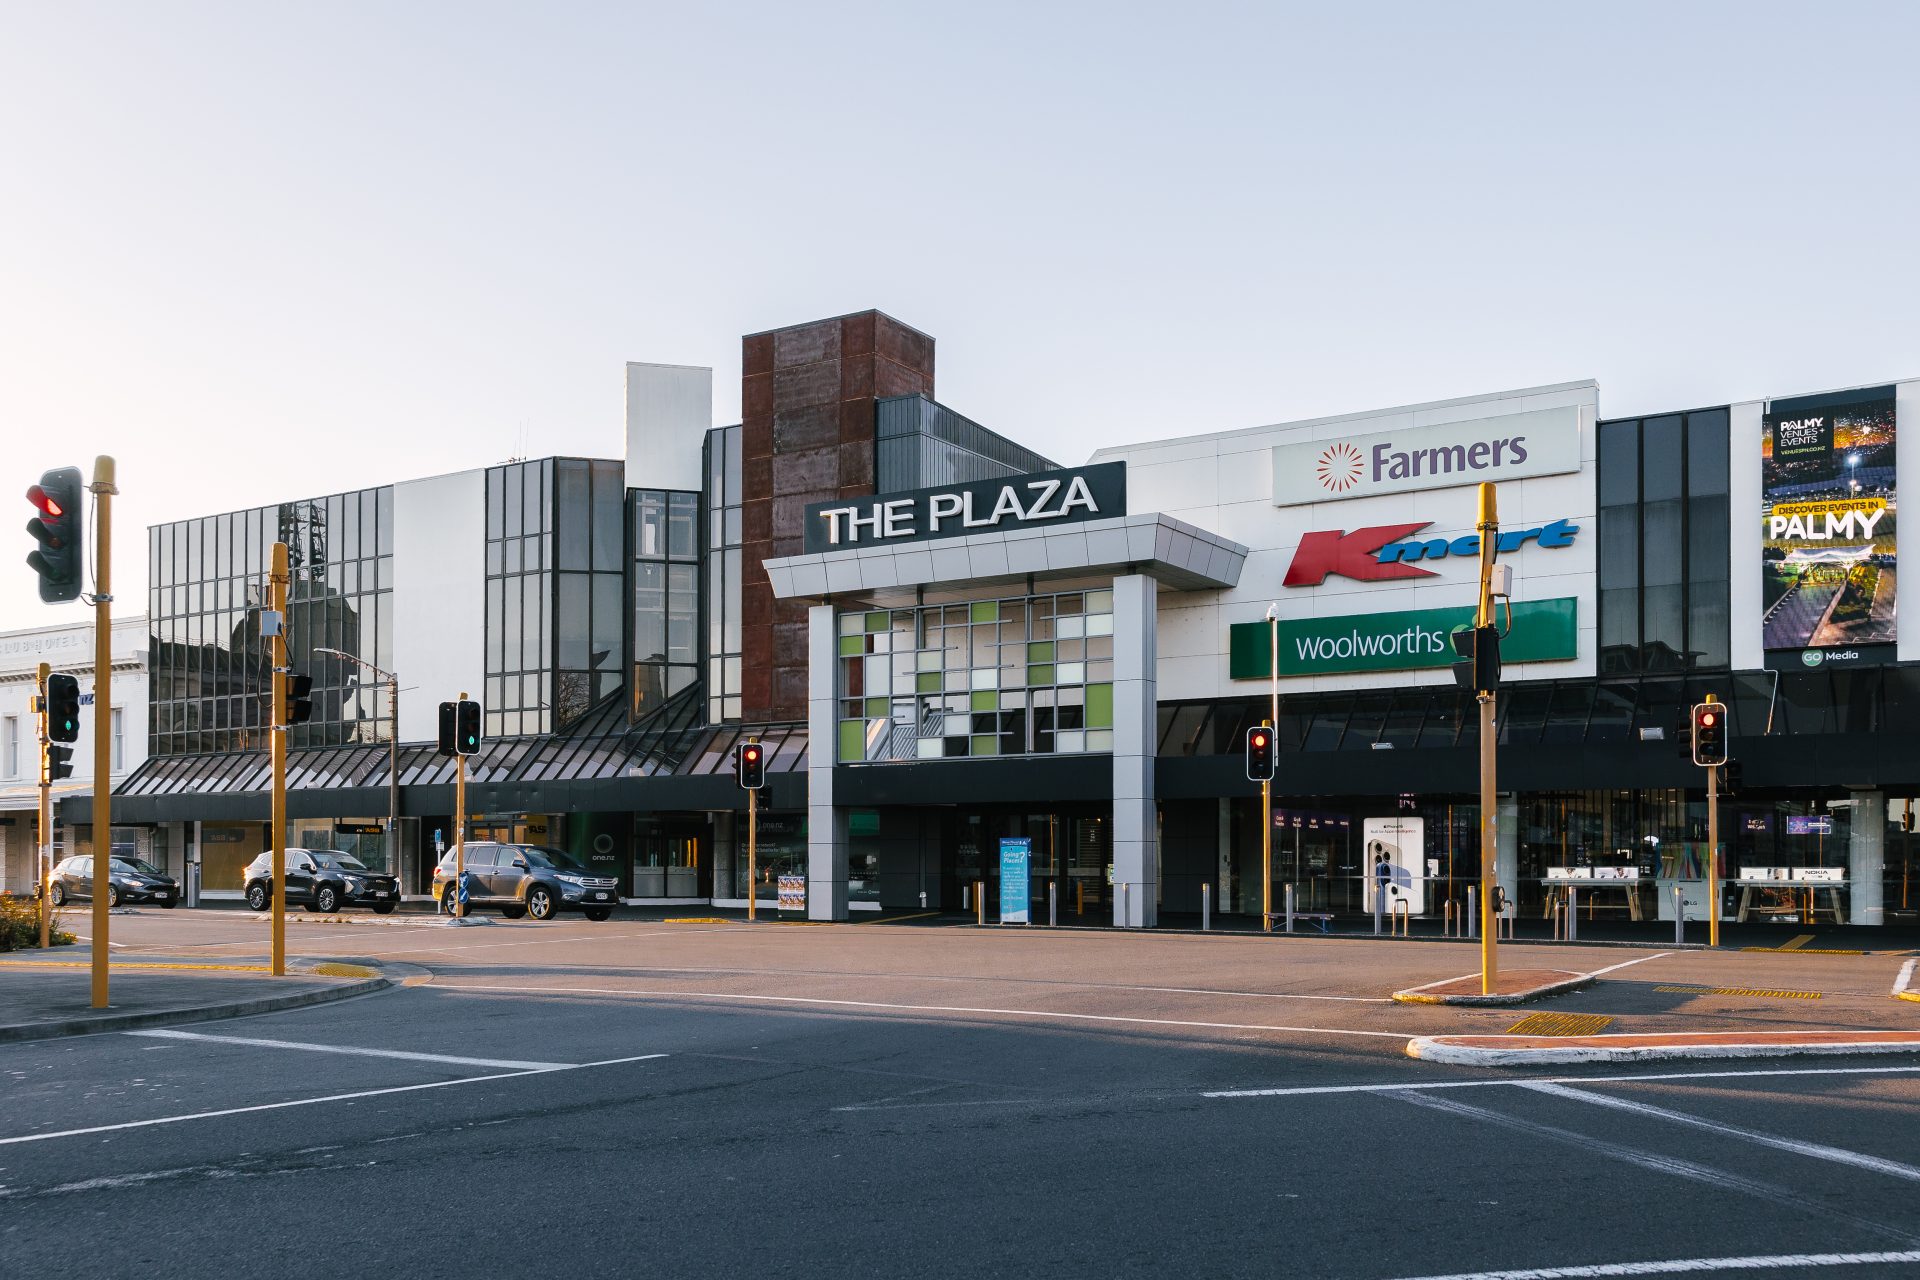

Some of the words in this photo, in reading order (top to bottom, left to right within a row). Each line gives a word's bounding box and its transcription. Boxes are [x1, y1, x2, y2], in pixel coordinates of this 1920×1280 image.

[1780, 428, 1817, 439] VENUES
[1780, 436, 1817, 447] EVENTS
[1372, 436, 1528, 482] Farmers
[820, 499, 916, 544] THE
[929, 476, 1099, 532] PLAZA
[1778, 505, 1827, 515] DISCOVER
[1828, 502, 1866, 512] EVENTS
[1868, 501, 1879, 509] IN
[1770, 508, 1885, 540] PALMY
[1804, 653, 1821, 662] GO
[1825, 651, 1859, 660] Media
